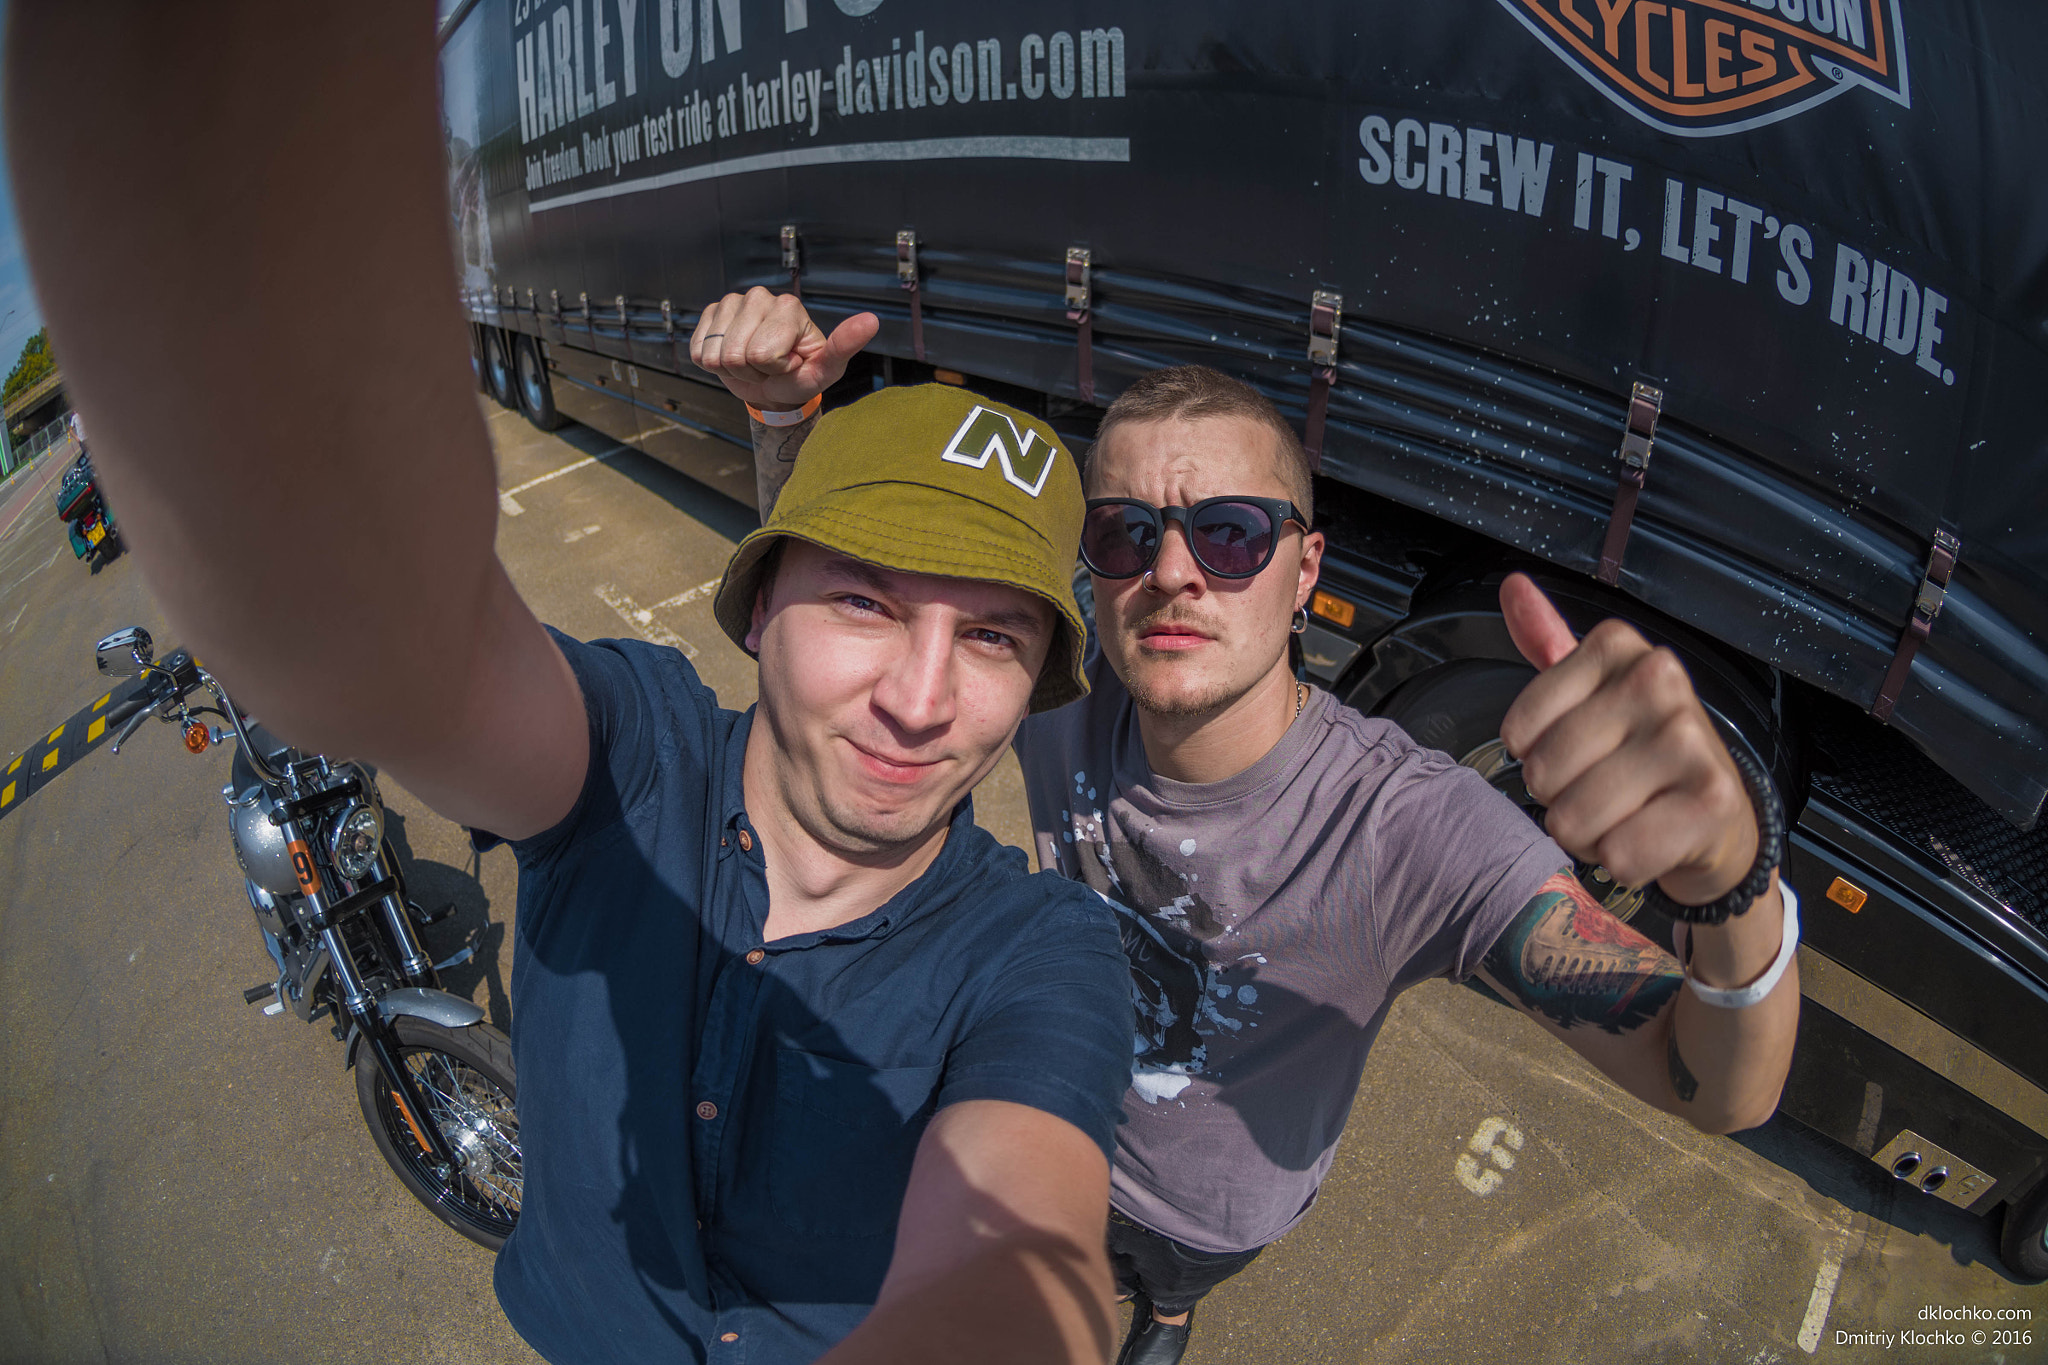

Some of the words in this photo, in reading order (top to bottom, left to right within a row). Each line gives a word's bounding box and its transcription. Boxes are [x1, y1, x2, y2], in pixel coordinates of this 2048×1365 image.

[516, 0, 637, 145] HARLEY
[582, 125, 612, 174] Book
[612, 123, 640, 177] your
[643, 106, 673, 158] test
[677, 88, 712, 149] ride
[718, 83, 737, 139] at
[742, 27, 1126, 137] harley-davidson.com
[1359, 114, 1554, 218] SCREW
[1573, 152, 1641, 251] IT,
[1661, 178, 1813, 306] LET'S
[1829, 242, 1955, 386] RIDE.
[941, 404, 1058, 499] N
[293, 851, 314, 885] 9
